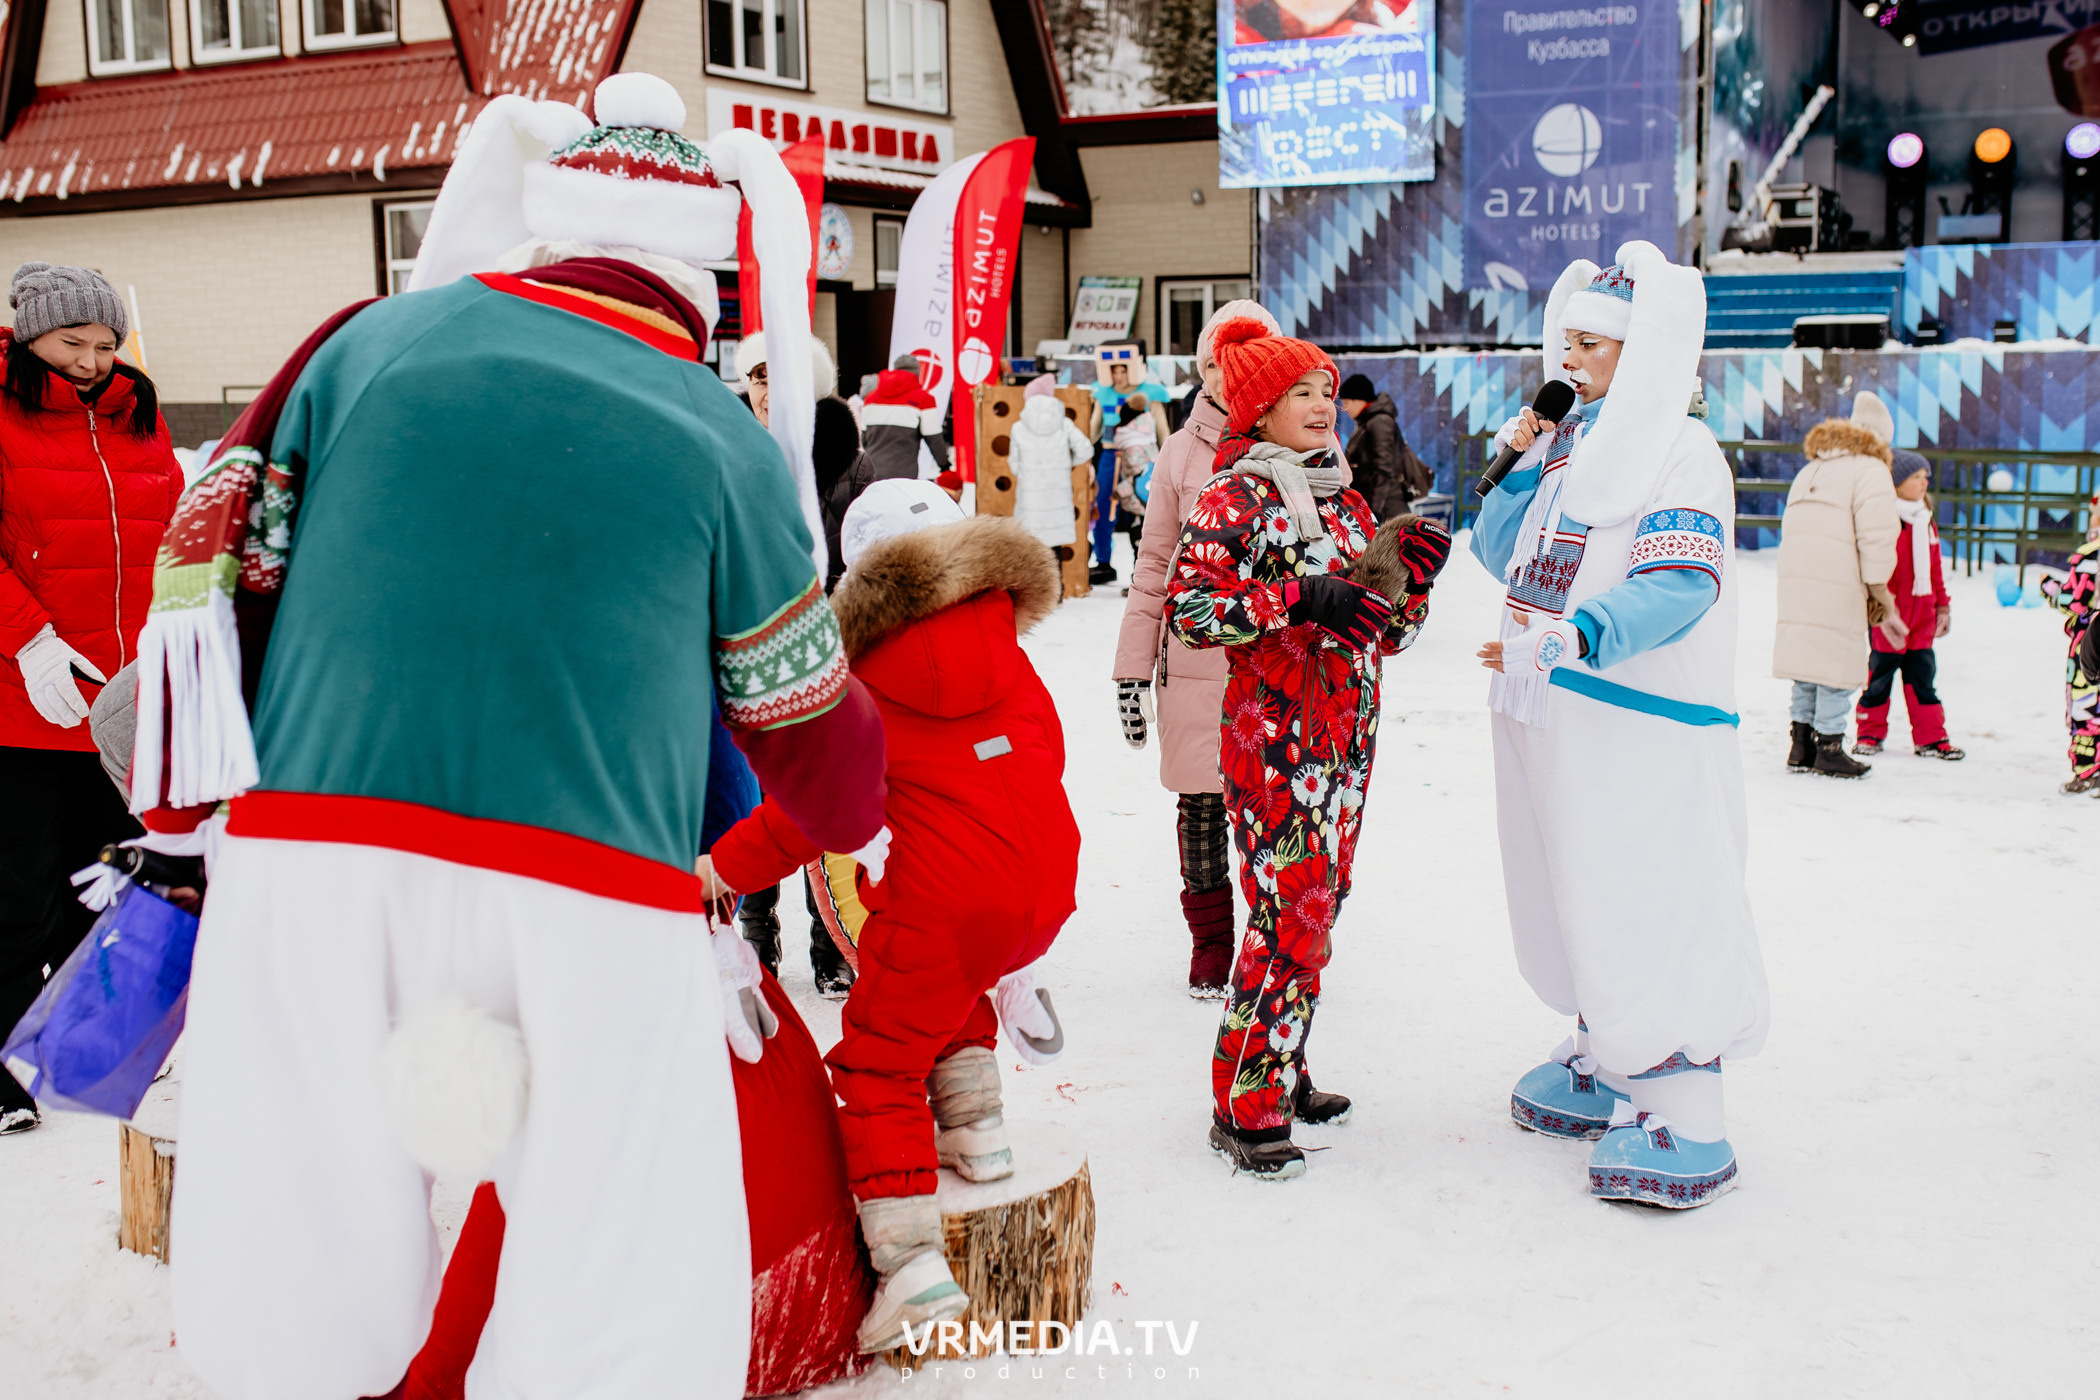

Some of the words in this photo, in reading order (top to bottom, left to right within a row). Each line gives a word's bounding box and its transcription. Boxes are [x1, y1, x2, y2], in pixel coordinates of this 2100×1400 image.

[1503, 5, 1637, 36] Правительство
[1527, 37, 1610, 65] Кузбасса
[733, 104, 940, 163] НЕВАЛЯШКА
[1531, 223, 1602, 242] HOTELS
[990, 248, 1007, 299] HOTELS
